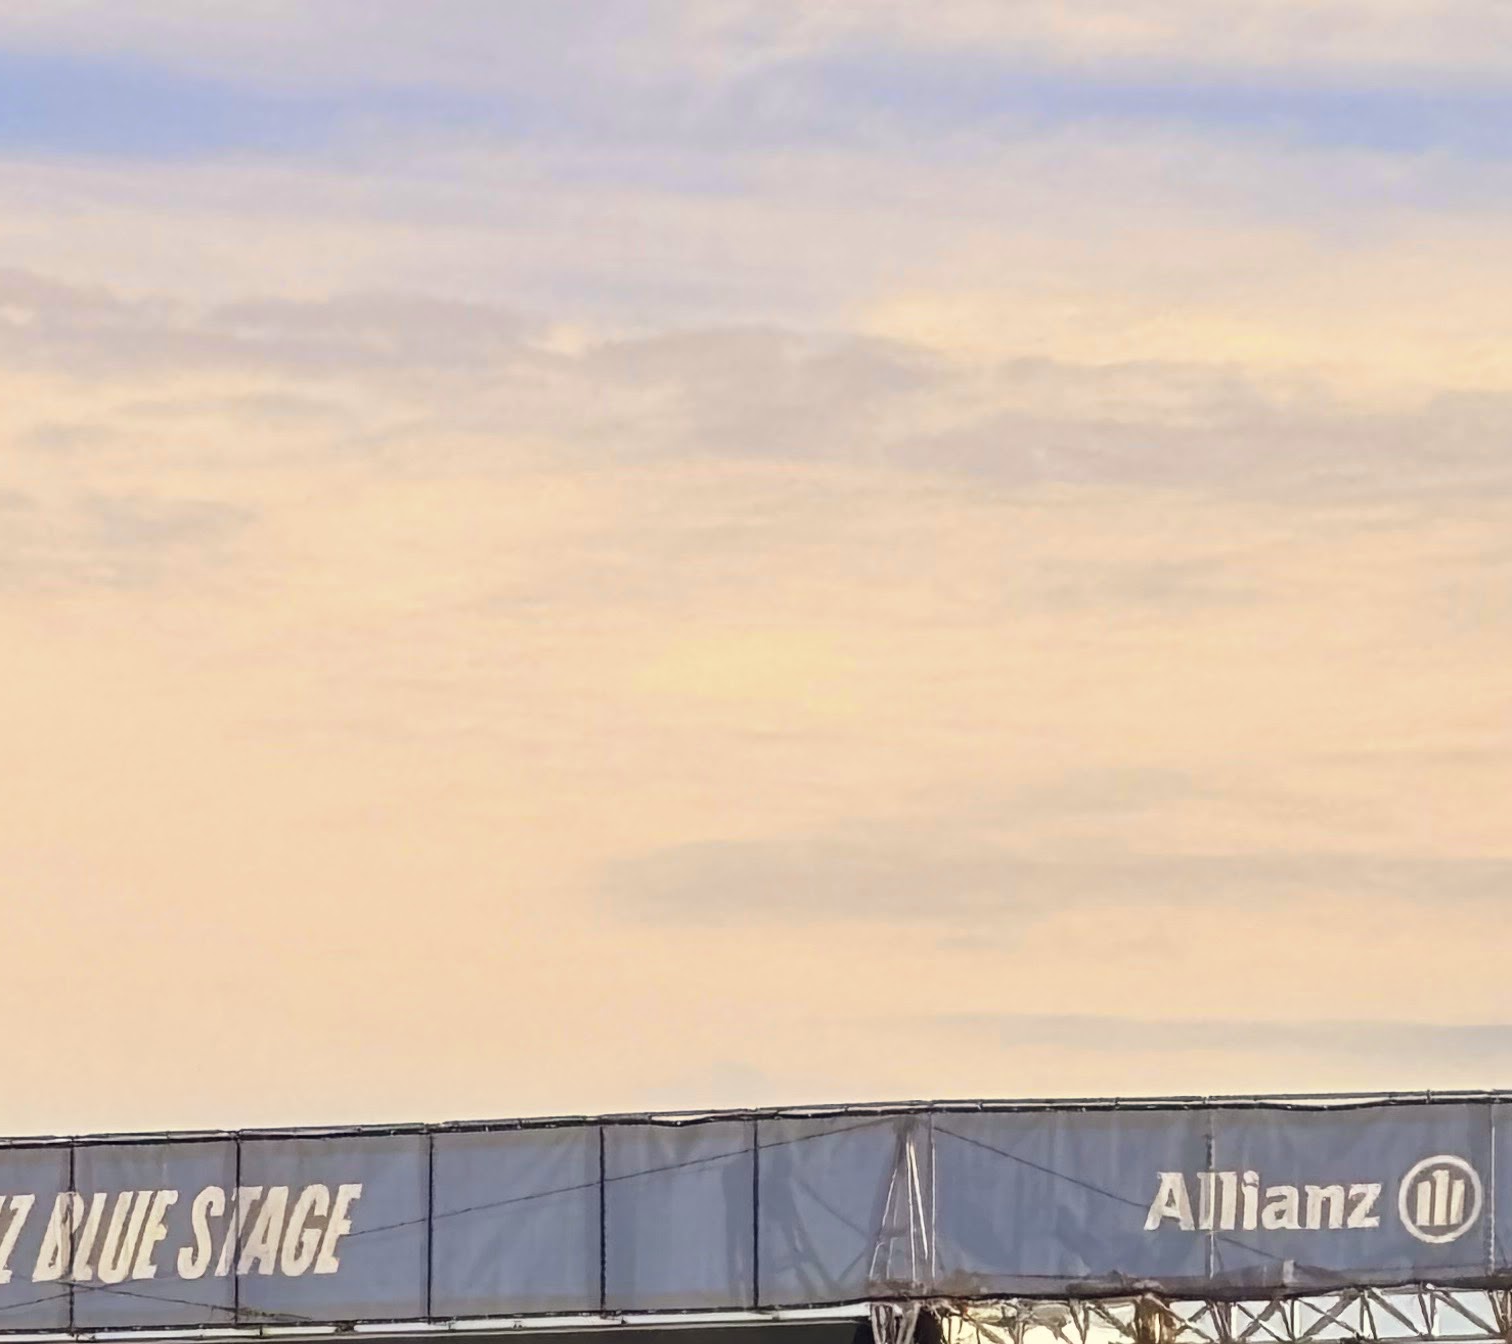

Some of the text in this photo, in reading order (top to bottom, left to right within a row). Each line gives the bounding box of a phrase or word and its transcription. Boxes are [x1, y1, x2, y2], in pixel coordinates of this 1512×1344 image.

[32, 1189, 178, 1283] BLUE
[177, 1182, 362, 1279] STAGE
[1143, 1170, 1382, 1232] Allianz
